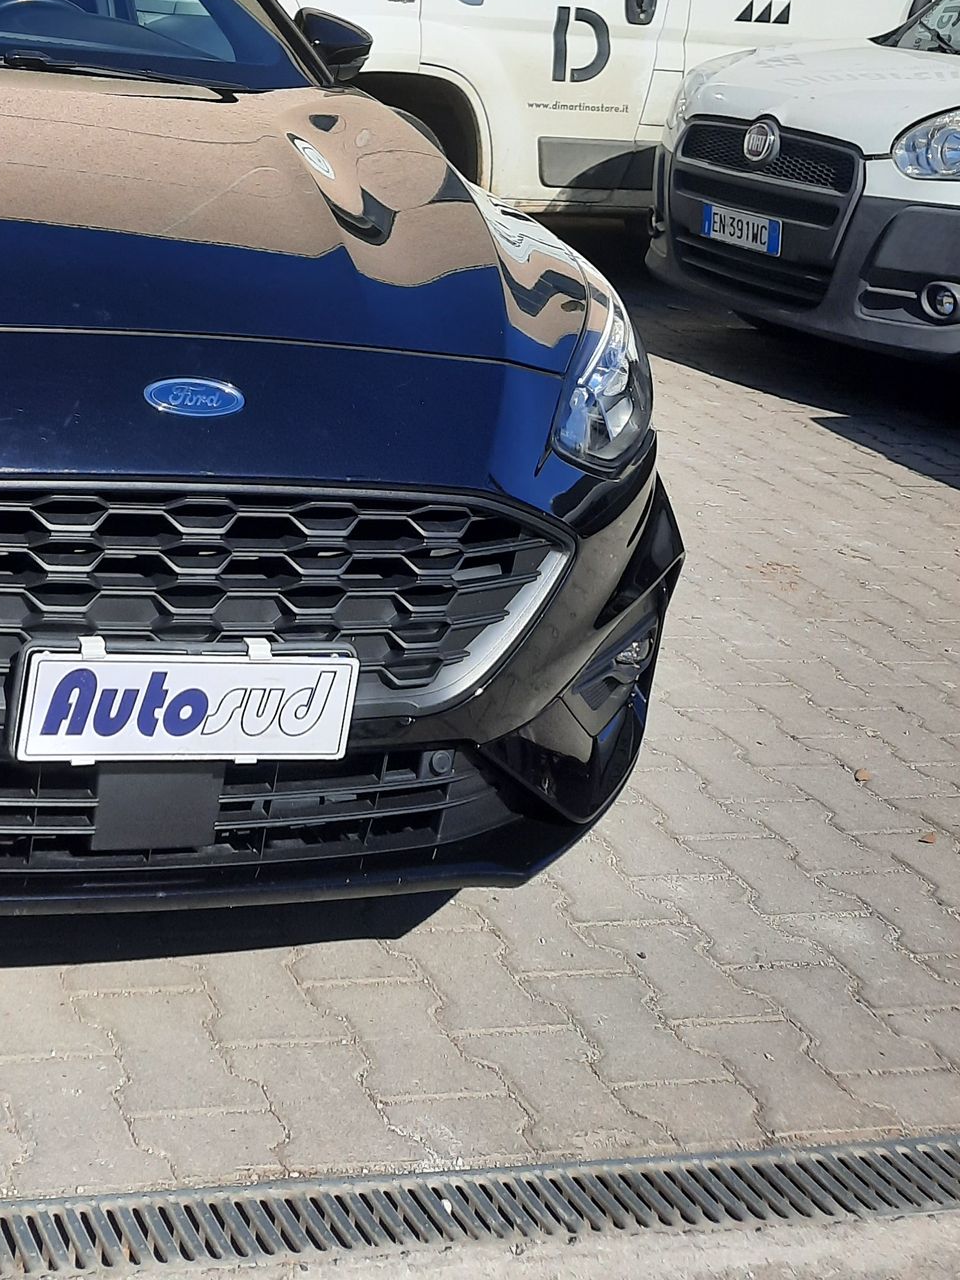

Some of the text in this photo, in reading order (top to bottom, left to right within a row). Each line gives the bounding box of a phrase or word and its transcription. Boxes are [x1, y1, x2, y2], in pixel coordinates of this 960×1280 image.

[552, 6, 611, 82] D
[712, 212, 768, 246] EN 391WC
[168, 385, 222, 408] Ford
[40, 667, 338, 737] Autosud
